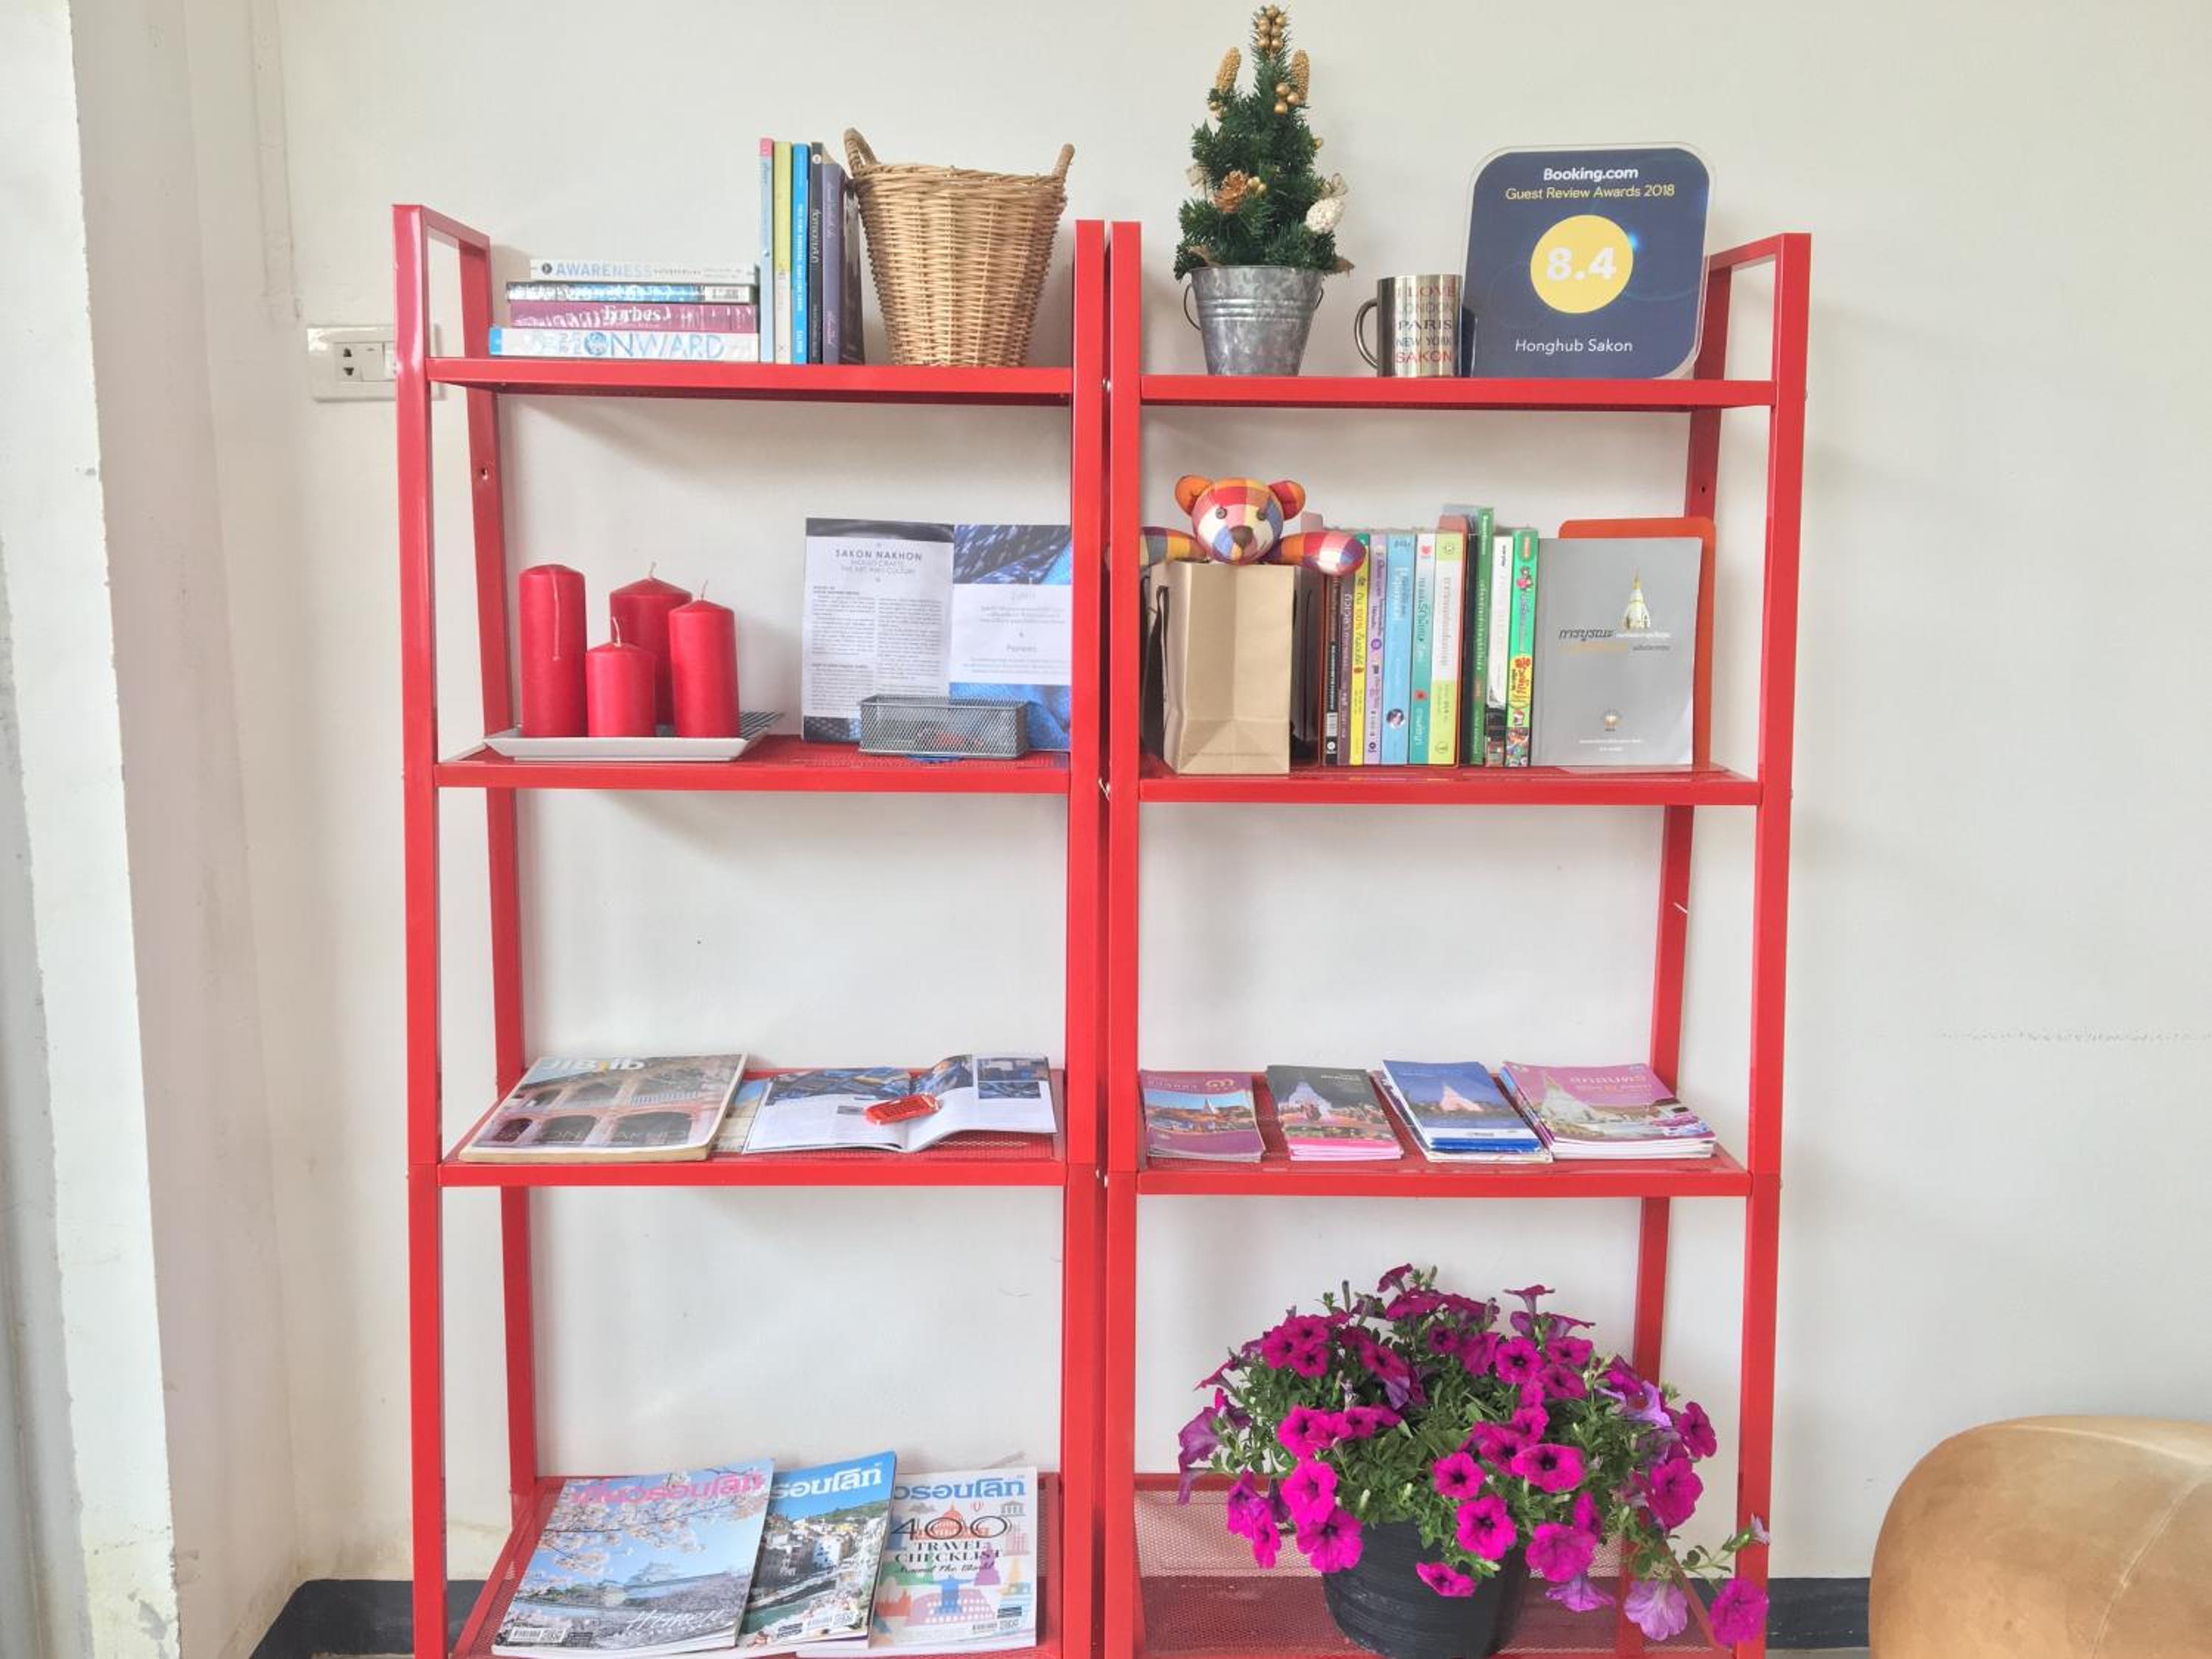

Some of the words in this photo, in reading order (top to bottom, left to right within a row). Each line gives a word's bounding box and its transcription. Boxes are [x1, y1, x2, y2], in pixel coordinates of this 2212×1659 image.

[1543, 167, 1638, 182] Booking.com
[1506, 188, 1543, 200] Guest
[1546, 187, 1590, 199] Review
[1593, 187, 1641, 198] Awards
[1644, 184, 1675, 197] 2018
[556, 262, 654, 277] AWARENESS
[1546, 247, 1616, 281] 8.4
[602, 305, 662, 323] Forbes
[1399, 319, 1452, 330] PARIS
[1515, 338, 1584, 355] Honghub
[1588, 338, 1632, 352] Sakon
[1395, 350, 1452, 364] SAKON
[835, 549, 872, 558] SAKON
[876, 551, 922, 560] NAKHON
[771, 1465, 882, 1498] รอบโลก
[891, 1515, 1012, 1540] 400
[914, 1541, 984, 1551] TRAVEL
[895, 1549, 1004, 1563] CHECKLIST
